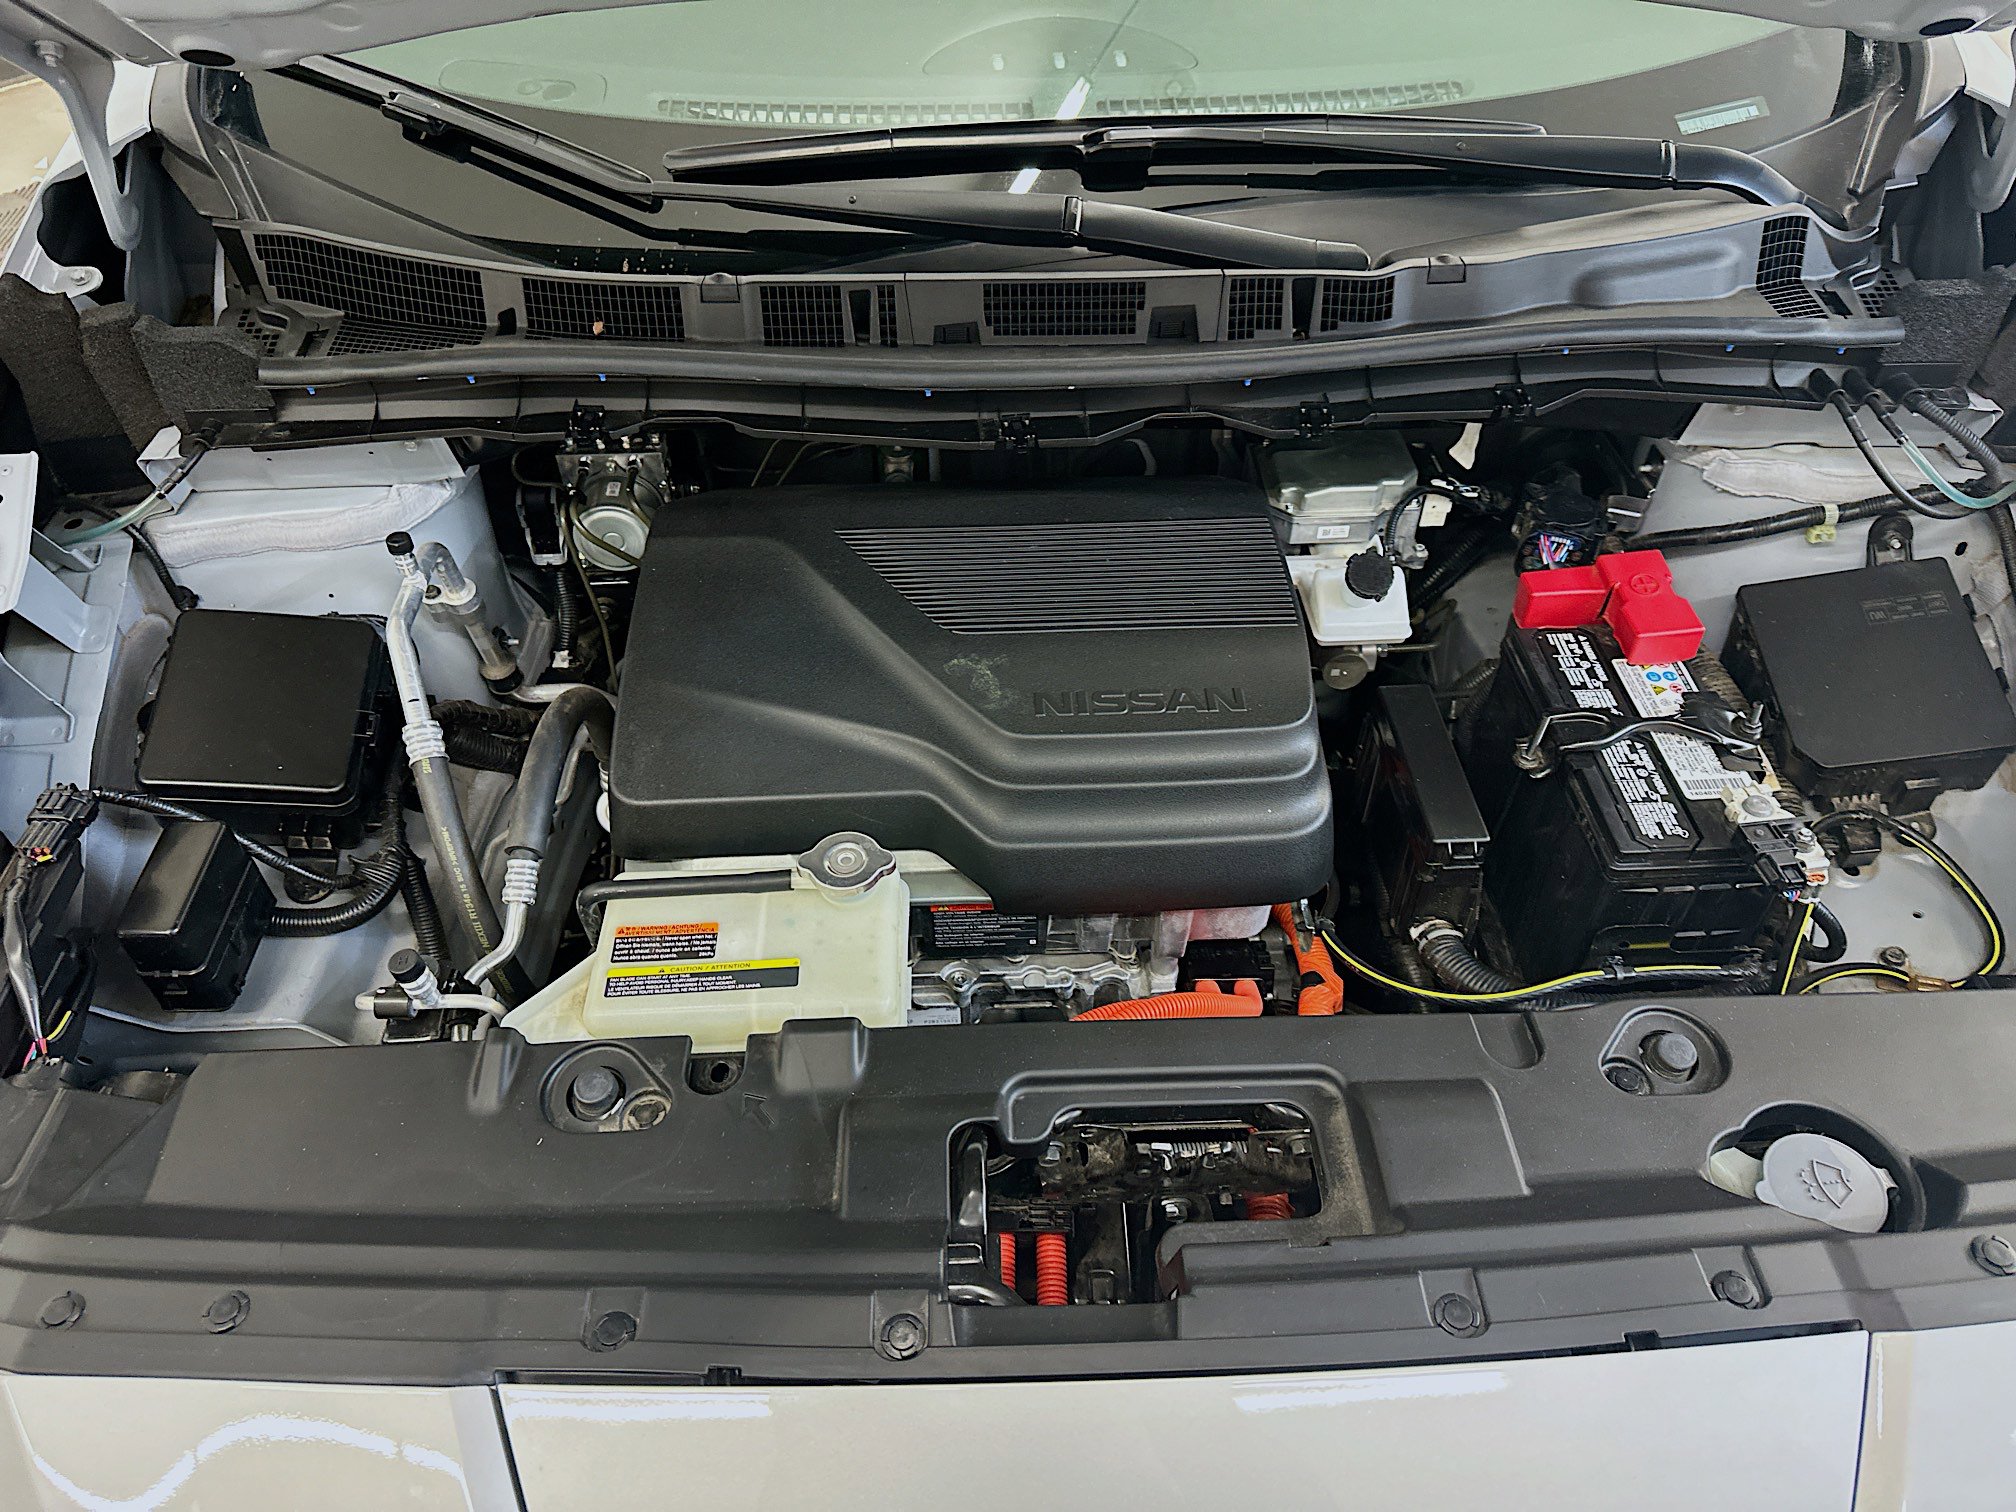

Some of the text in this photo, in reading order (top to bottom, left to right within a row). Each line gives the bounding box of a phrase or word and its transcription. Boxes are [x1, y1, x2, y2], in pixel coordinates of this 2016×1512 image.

[1033, 687, 1248, 718] NISSAN
[452, 866, 464, 882] SUC
[461, 892, 478, 919] R134a
[669, 965, 703, 973] CAUTION
[711, 962, 751, 971] ATTENTION
